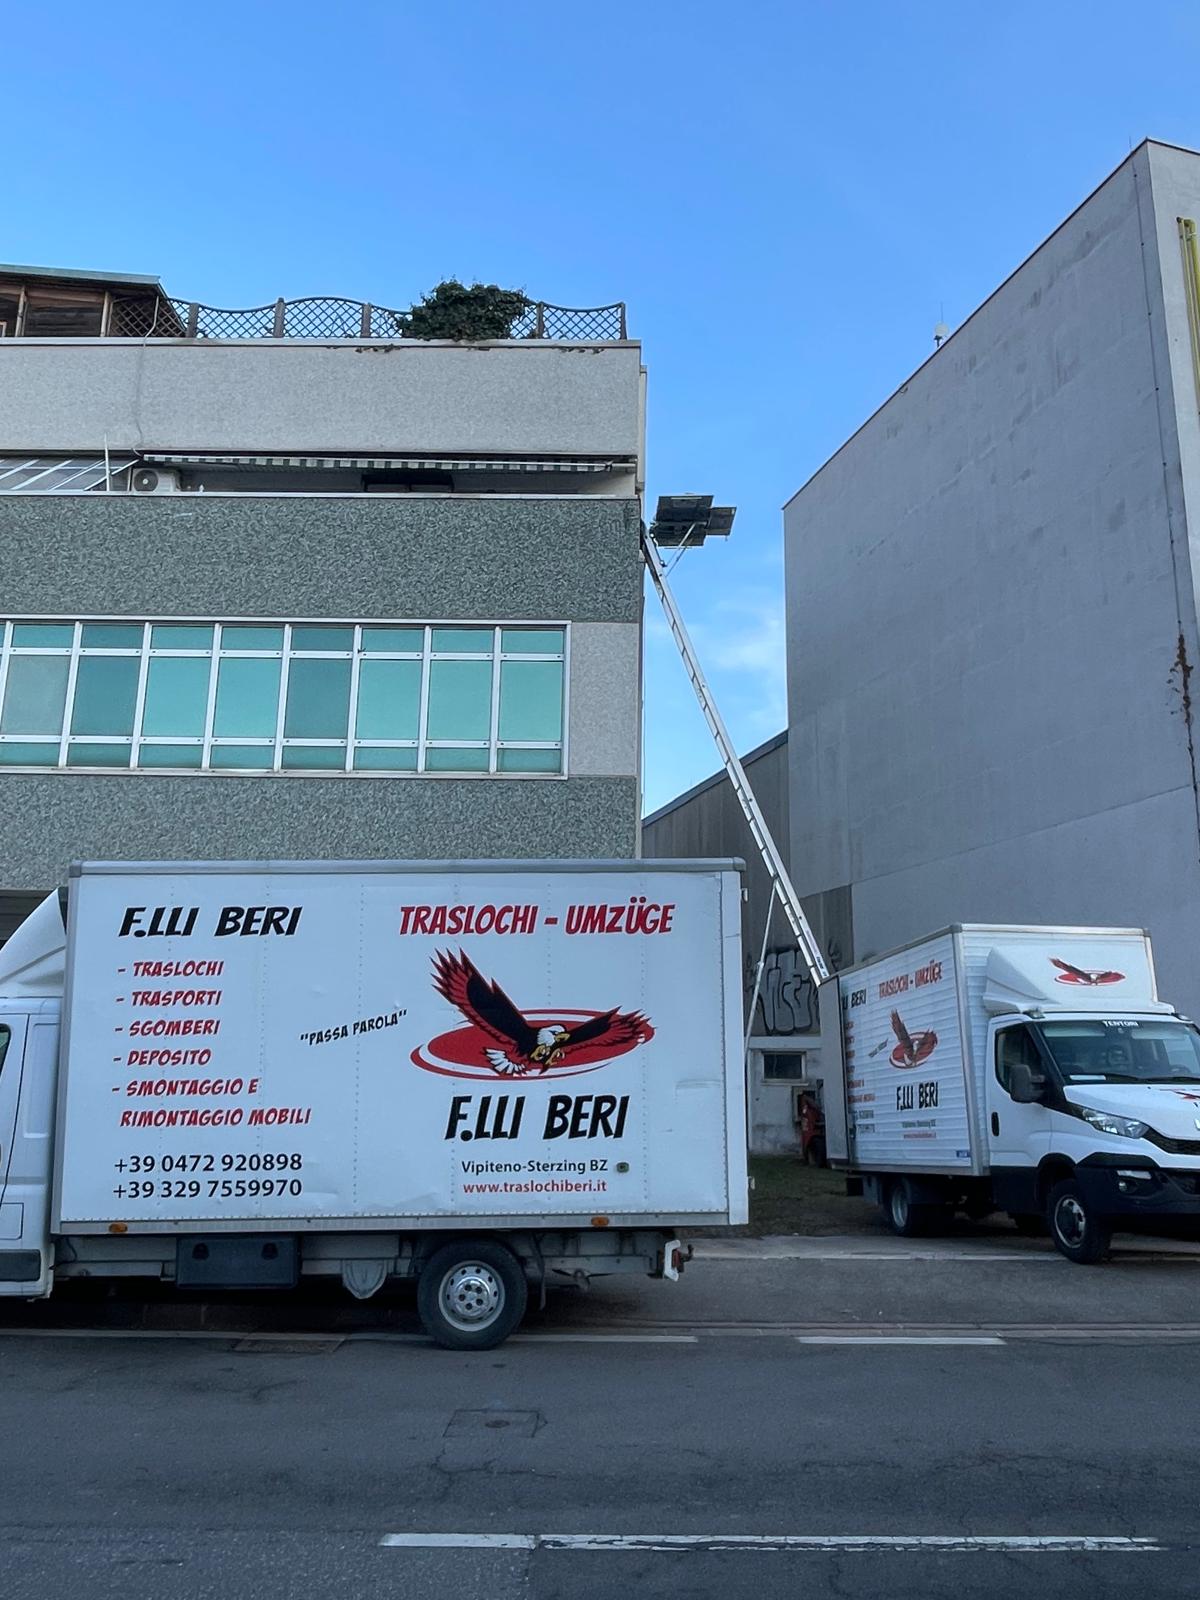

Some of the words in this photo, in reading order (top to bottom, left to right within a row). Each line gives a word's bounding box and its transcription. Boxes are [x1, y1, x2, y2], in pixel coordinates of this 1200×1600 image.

[118, 907, 200, 937] F.LLI
[214, 906, 303, 937] BERI
[400, 905, 538, 935] TRASLOCHI
[566, 897, 675, 934] UMZÜGE
[134, 961, 224, 977] TRASLOCHI
[133, 991, 221, 1006] TRASPORTI
[851, 989, 866, 1008] BERI
[130, 1020, 220, 1036] SGOMBERI
[128, 1049, 211, 1065] DEPOSITO
[127, 1079, 243, 1096] SMONTAGGIO
[248, 1079, 258, 1093] E
[919, 1082, 938, 1109] BERI
[120, 1109, 243, 1127] RIMONTAGGIO
[248, 1108, 311, 1126] MOBILI
[444, 1095, 525, 1142] F.LLI
[543, 1094, 630, 1140] BERI
[114, 1155, 155, 1173] +39
[161, 1154, 214, 1172] 0472
[221, 1153, 302, 1172] 920898
[462, 1160, 585, 1176] Vipiteno-Sterzing
[590, 1159, 608, 1171] BZ
[113, 1181, 154, 1198] +39
[161, 1180, 200, 1198] 329
[207, 1178, 302, 1197] 7559970
[463, 1179, 606, 1193] www.traslochiberi.it
